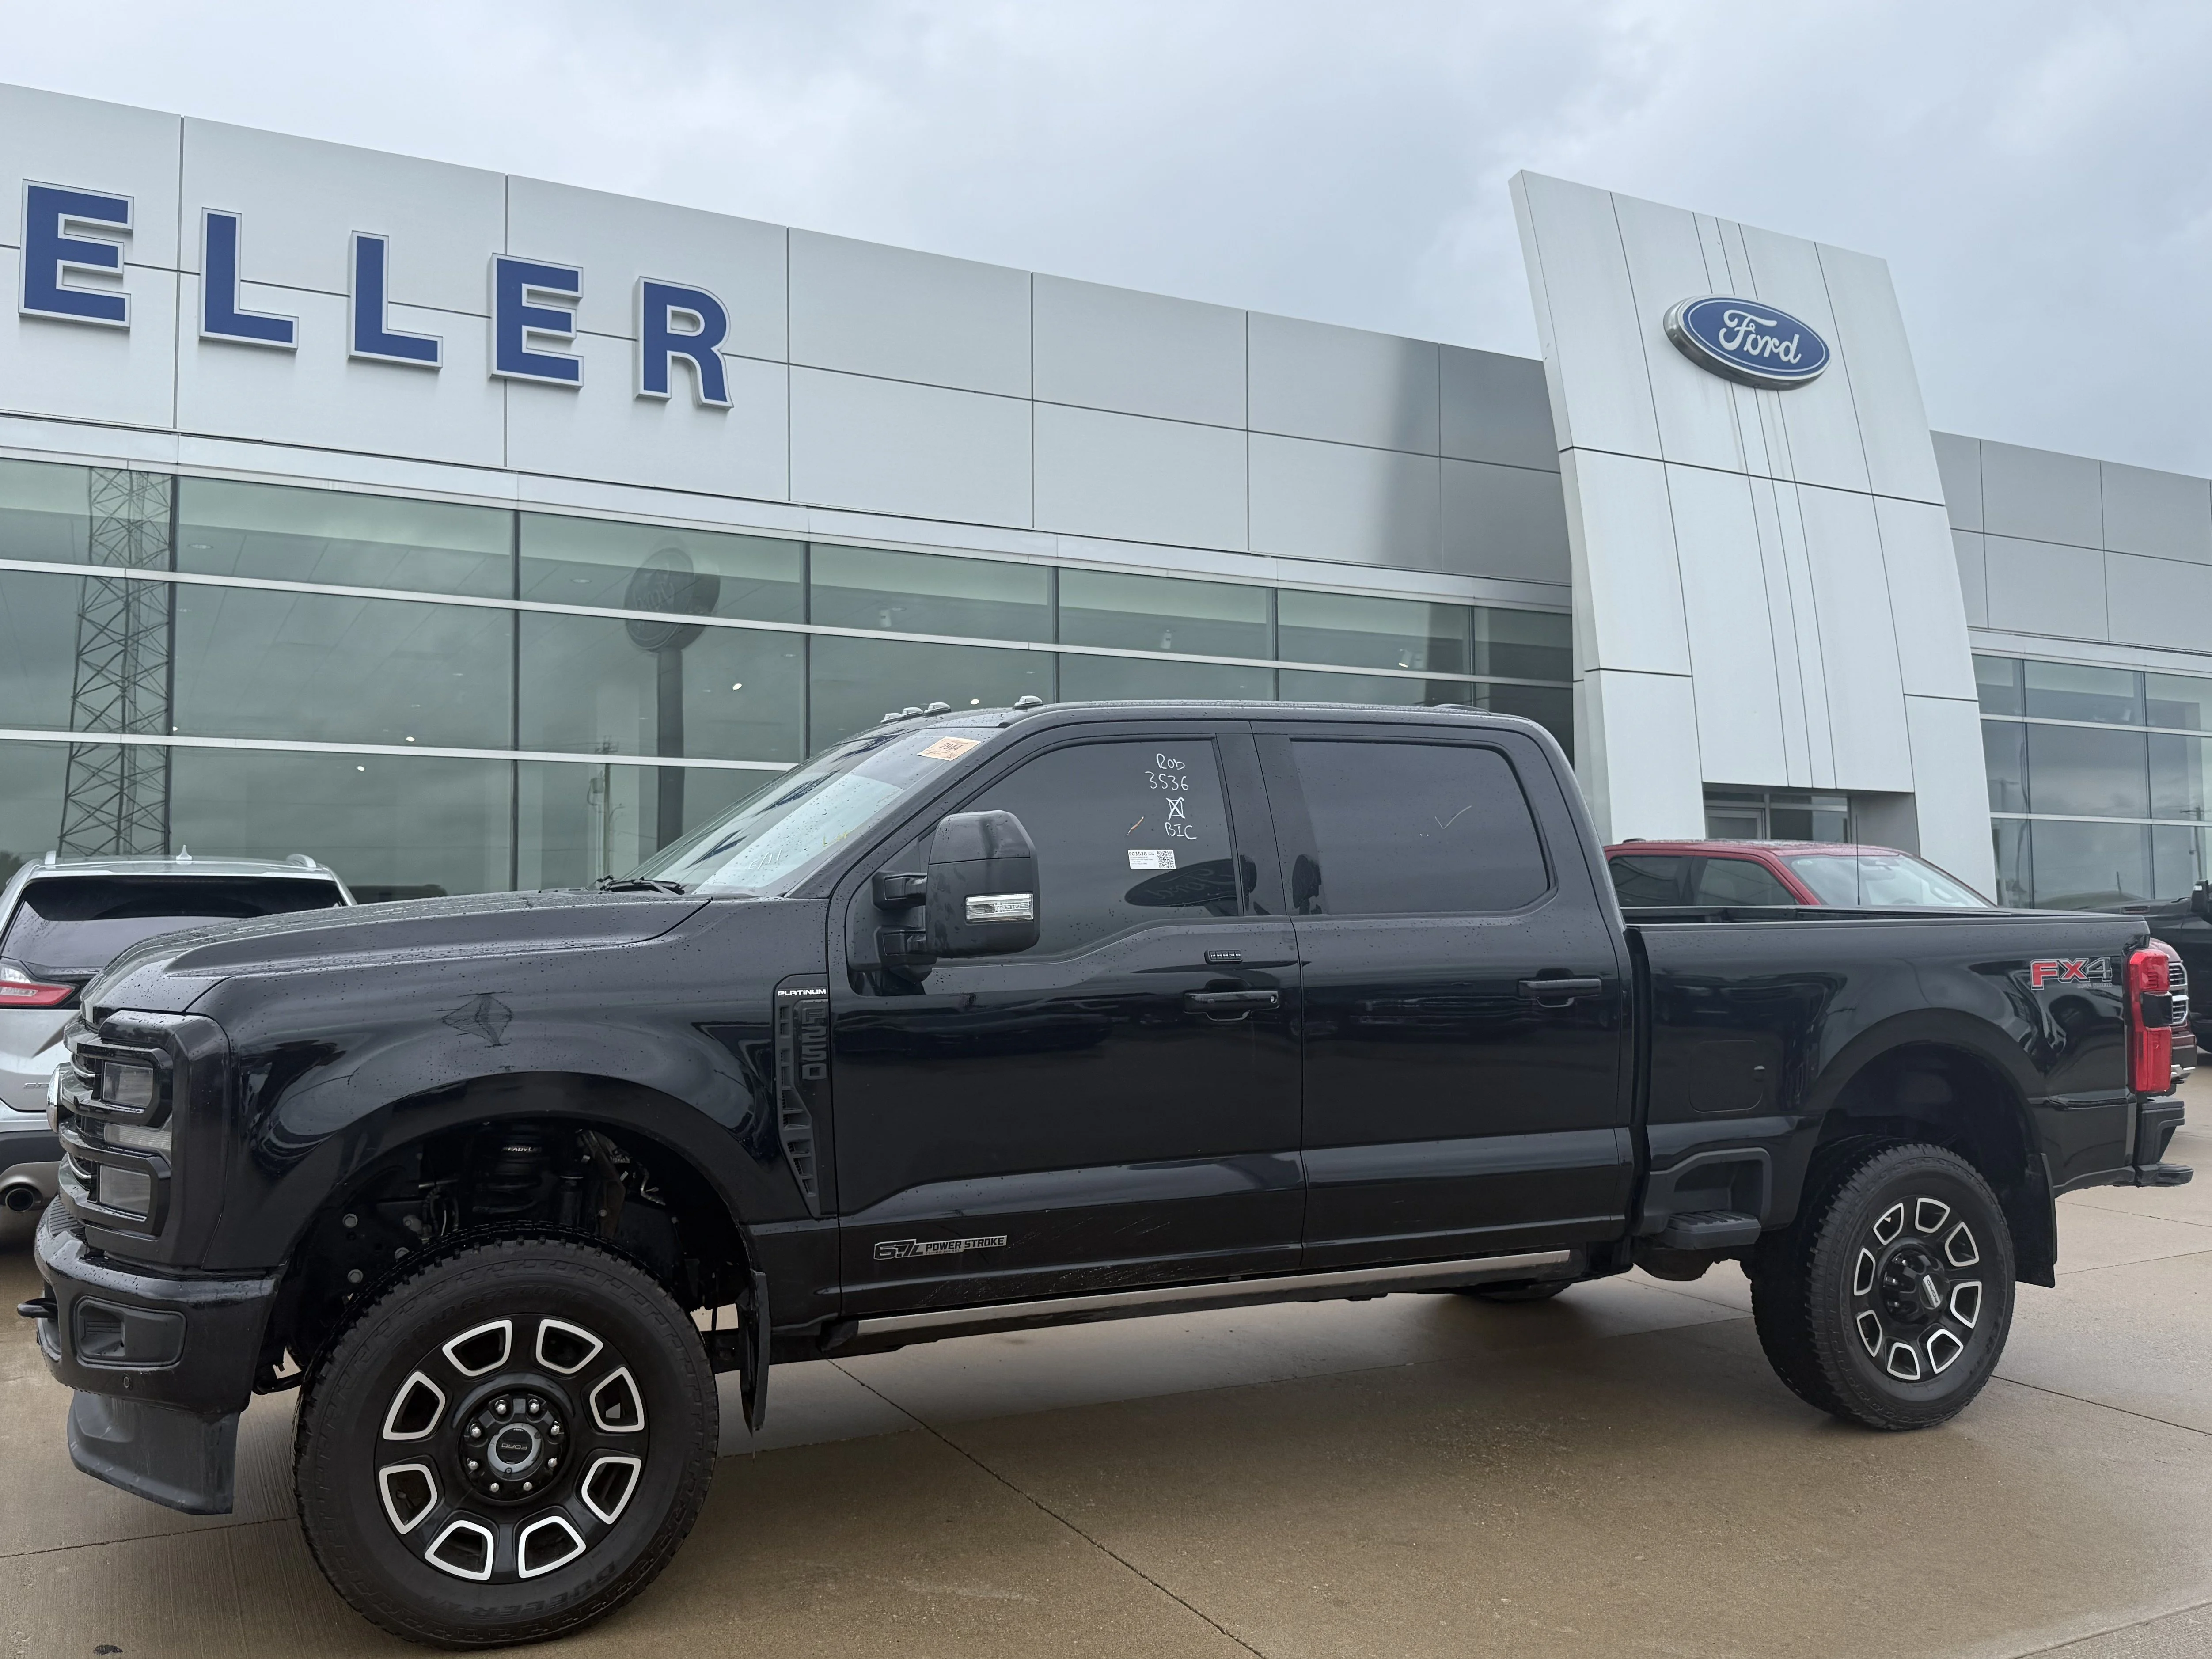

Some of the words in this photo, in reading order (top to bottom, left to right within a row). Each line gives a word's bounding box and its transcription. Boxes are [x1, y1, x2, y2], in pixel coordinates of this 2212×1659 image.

[19, 178, 734, 410] ELLER
[1719, 309, 1802, 364] Ford
[1145, 771, 1188, 790] 3536
[1165, 822, 1197, 839] BIC
[2030, 957, 2112, 990] FX4
[925, 1240, 962, 1252] POWER
[964, 1237, 1005, 1248] STROKE
